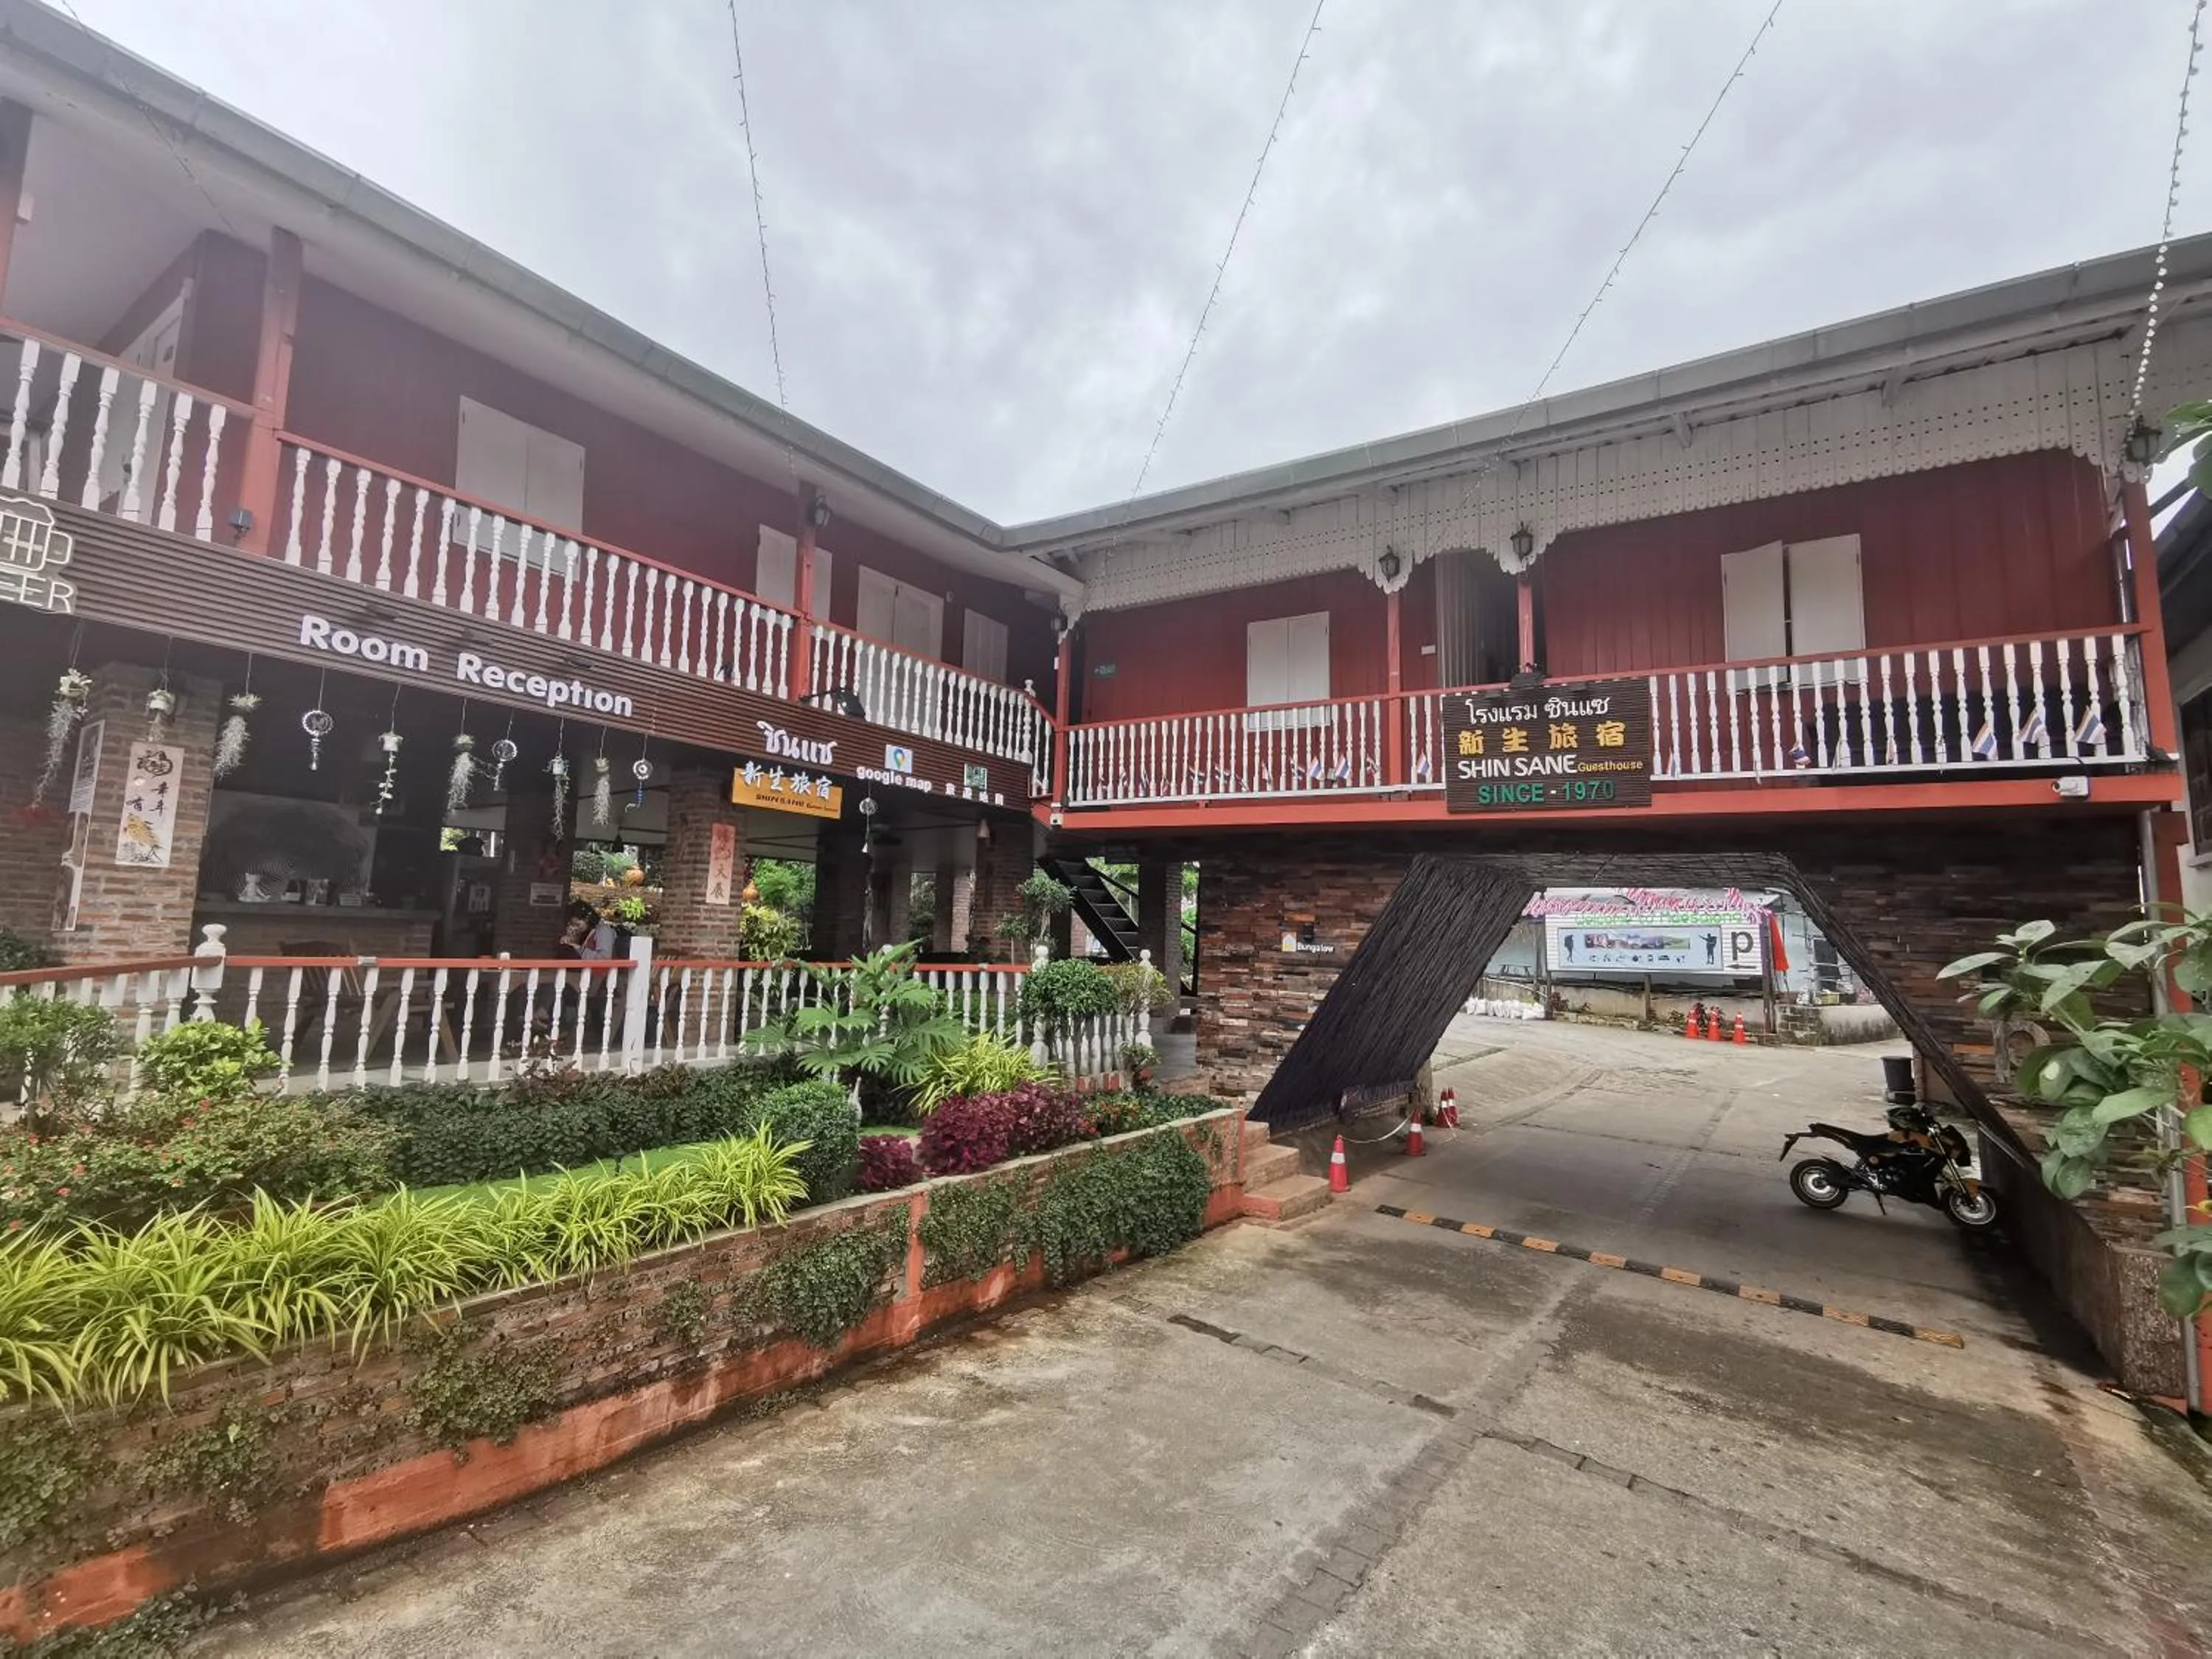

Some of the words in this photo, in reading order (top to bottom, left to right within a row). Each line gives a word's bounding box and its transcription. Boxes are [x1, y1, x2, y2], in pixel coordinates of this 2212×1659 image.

[300, 615, 429, 672] Room
[457, 652, 633, 717] Reception
[1465, 699, 1537, 724] โรงแรม
[1458, 757, 1511, 779] SHIN
[1514, 754, 1578, 776] SANE
[1577, 759, 1644, 773] Guesthouse
[741, 761, 832, 800] 新生旅宿
[856, 766, 902, 785] google
[905, 776, 932, 793] map
[1478, 783, 1545, 804] SINCE
[1562, 779, 1615, 801] 1970
[1298, 942, 1334, 953] Bungalow
